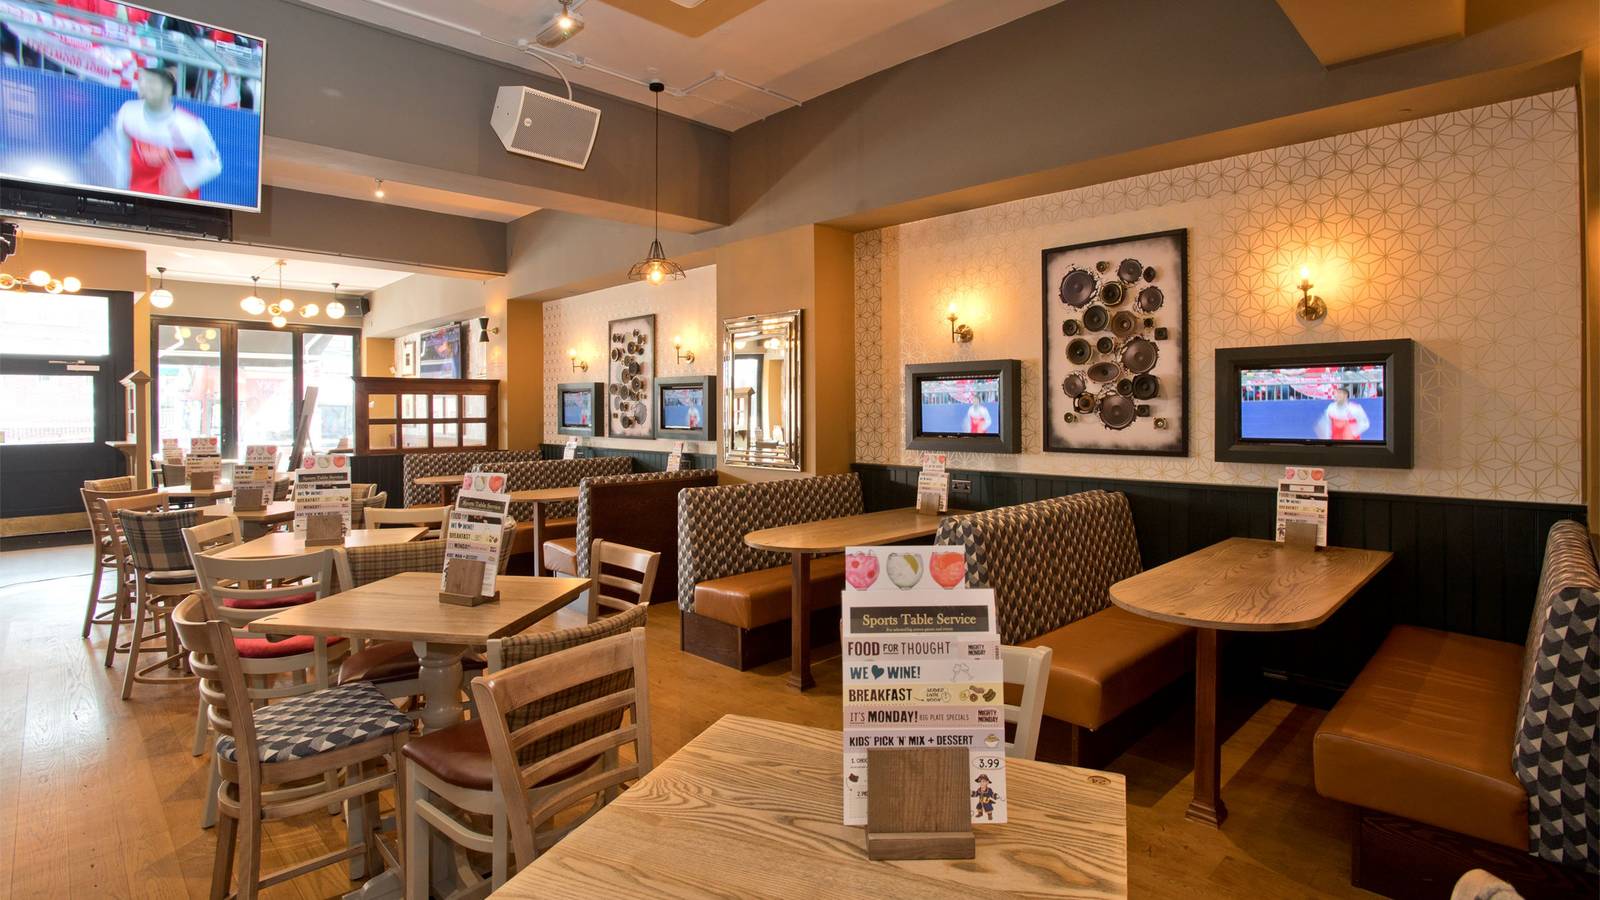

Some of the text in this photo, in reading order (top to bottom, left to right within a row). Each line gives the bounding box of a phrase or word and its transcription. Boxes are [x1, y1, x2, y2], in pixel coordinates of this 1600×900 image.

[862, 612, 977, 629] Sports Table Service
[848, 641, 951, 656] FOOD FOR THOUGHT
[850, 666, 921, 680] WE WINE!
[848, 688, 913, 702] BREAKFAST
[850, 711, 865, 723] IT'S
[868, 710, 918, 723] MONDAY!
[929, 713, 944, 721] PLATE
[946, 713, 970, 721] SPECIALS
[849, 736, 871, 747] KIDS'
[874, 735, 895, 746] PICK
[908, 735, 925, 746] MIX
[936, 735, 974, 746] DESSERT
[978, 758, 1000, 769] 3.99
